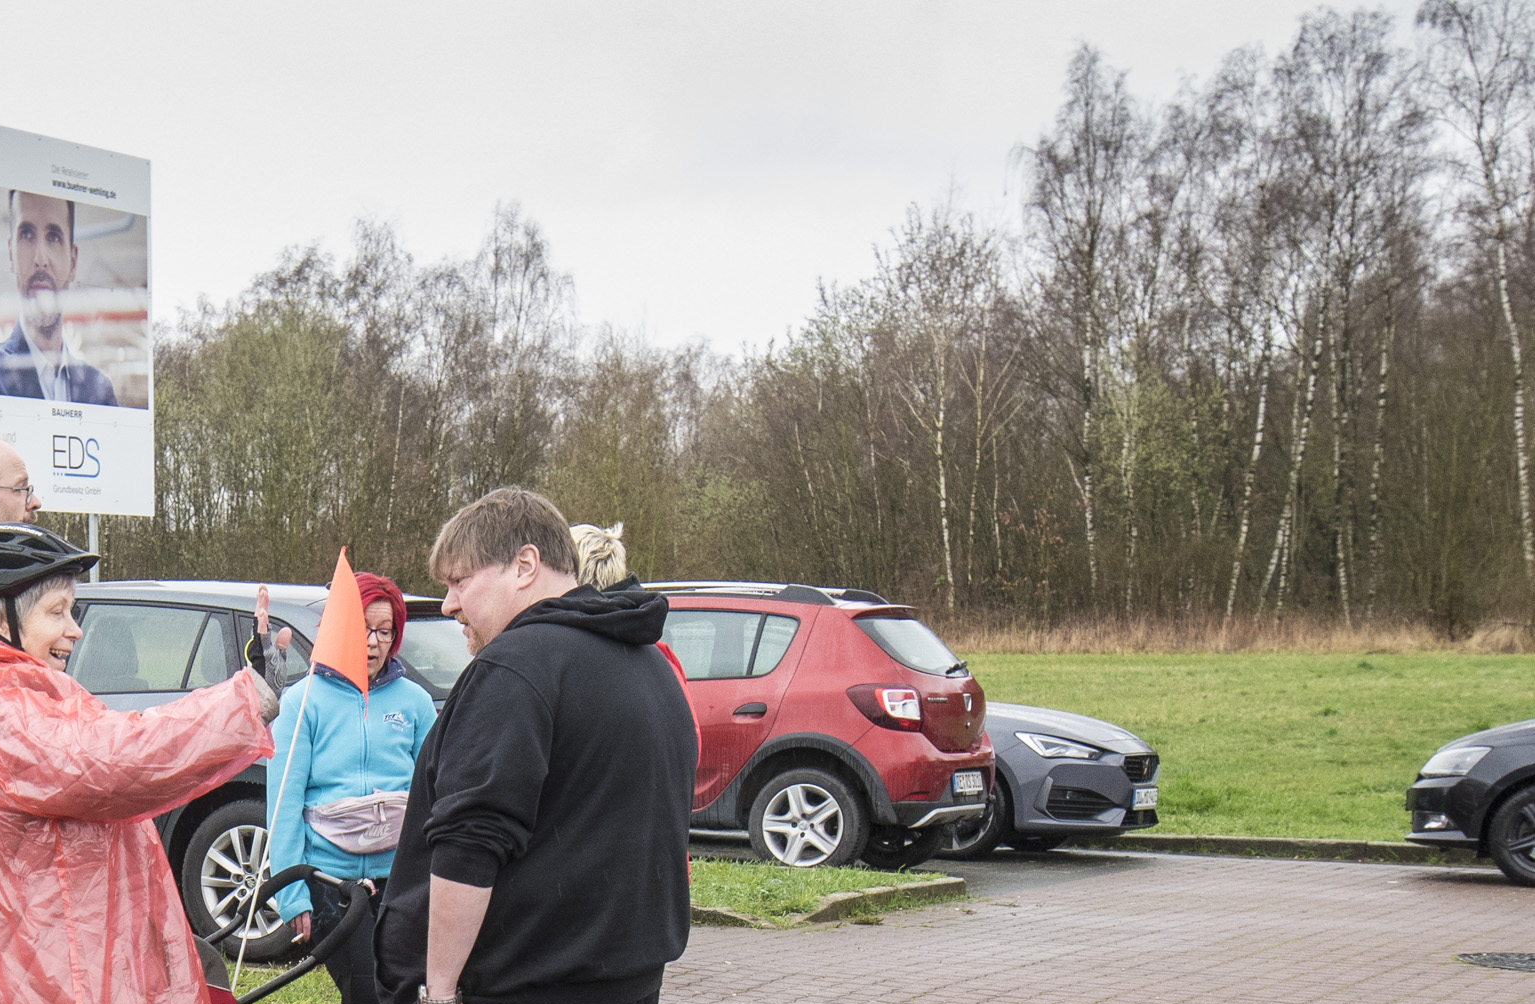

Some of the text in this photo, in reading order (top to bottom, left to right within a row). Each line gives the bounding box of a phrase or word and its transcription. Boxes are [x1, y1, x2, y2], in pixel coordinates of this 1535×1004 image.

[52, 180, 117, 199] www.buehrer-wehling.de
[52, 407, 83, 418] BAUHERR
[53, 435, 101, 478] EDS
[52, 484, 102, 495] Grundbesitz GmbH
[364, 823, 392, 837] NIKE
